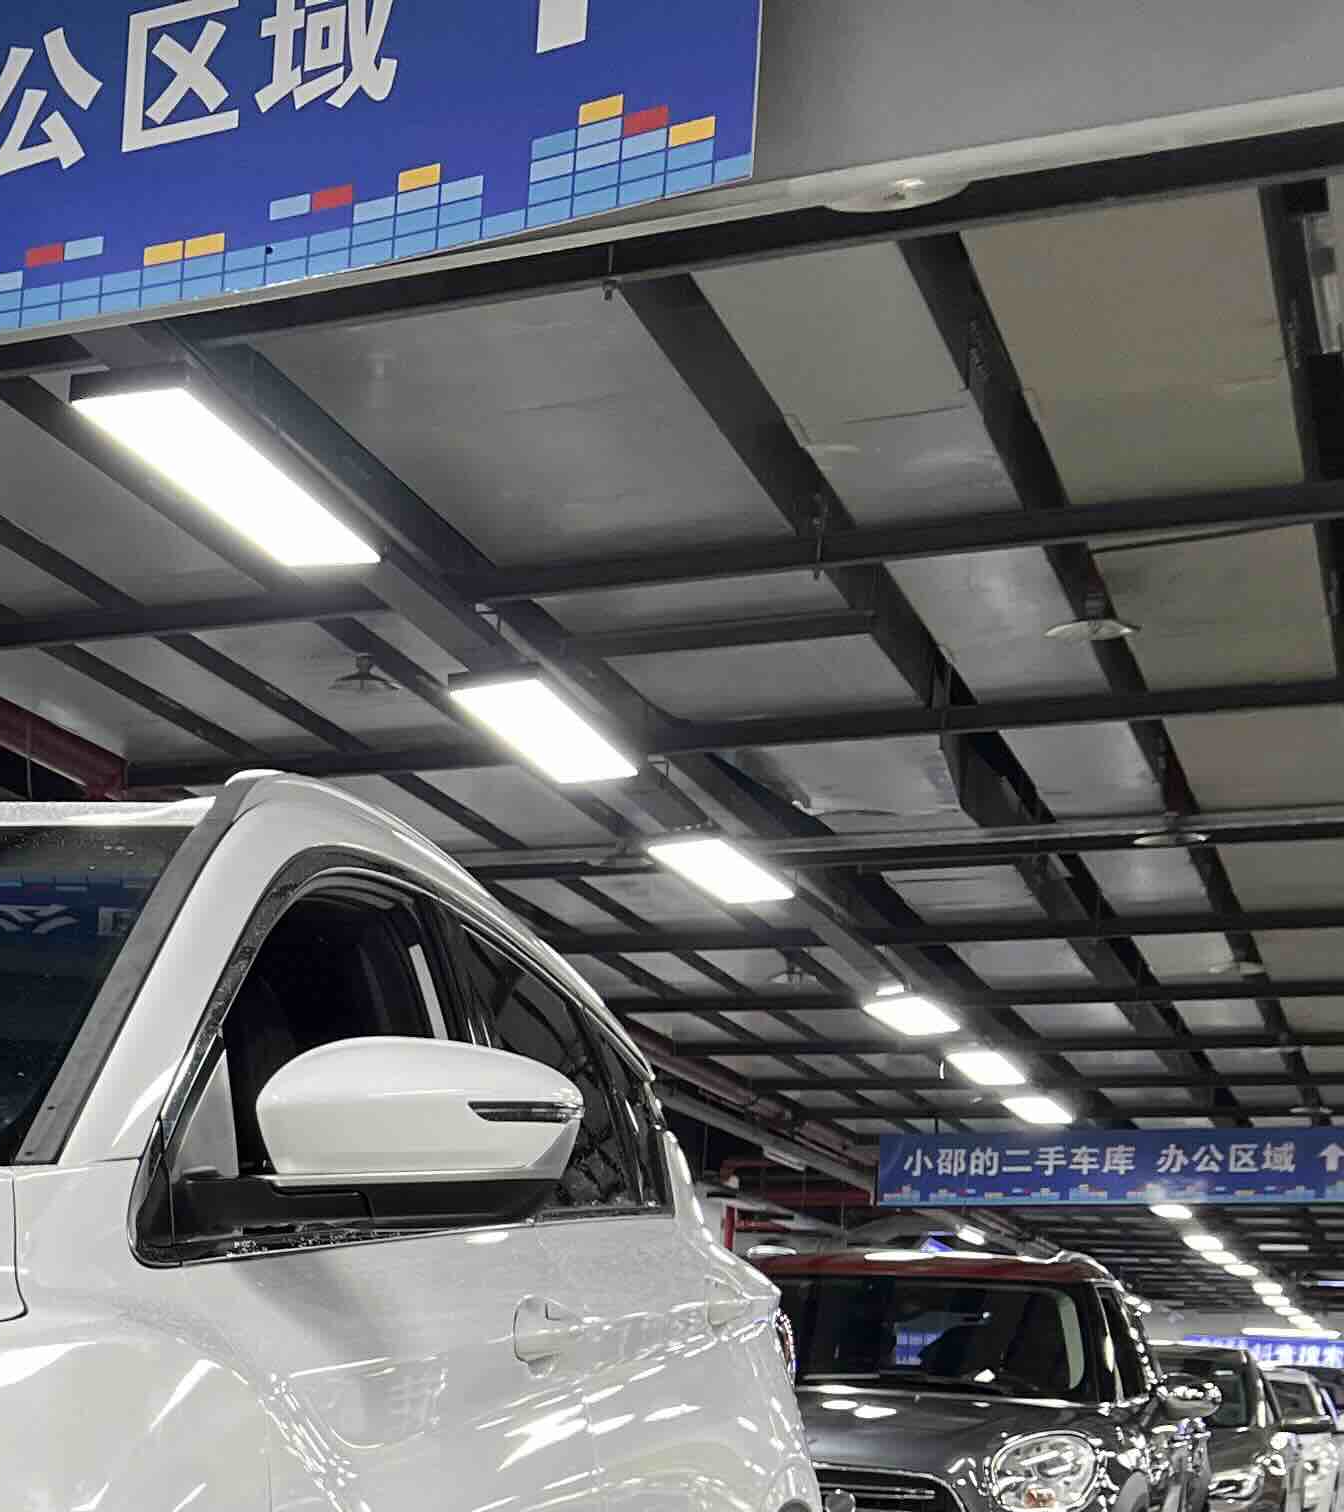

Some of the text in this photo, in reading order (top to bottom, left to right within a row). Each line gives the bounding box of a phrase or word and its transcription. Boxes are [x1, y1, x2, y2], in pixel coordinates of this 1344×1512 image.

[903, 1142, 1295, 1177] 小邵的二手车库 办公区域
